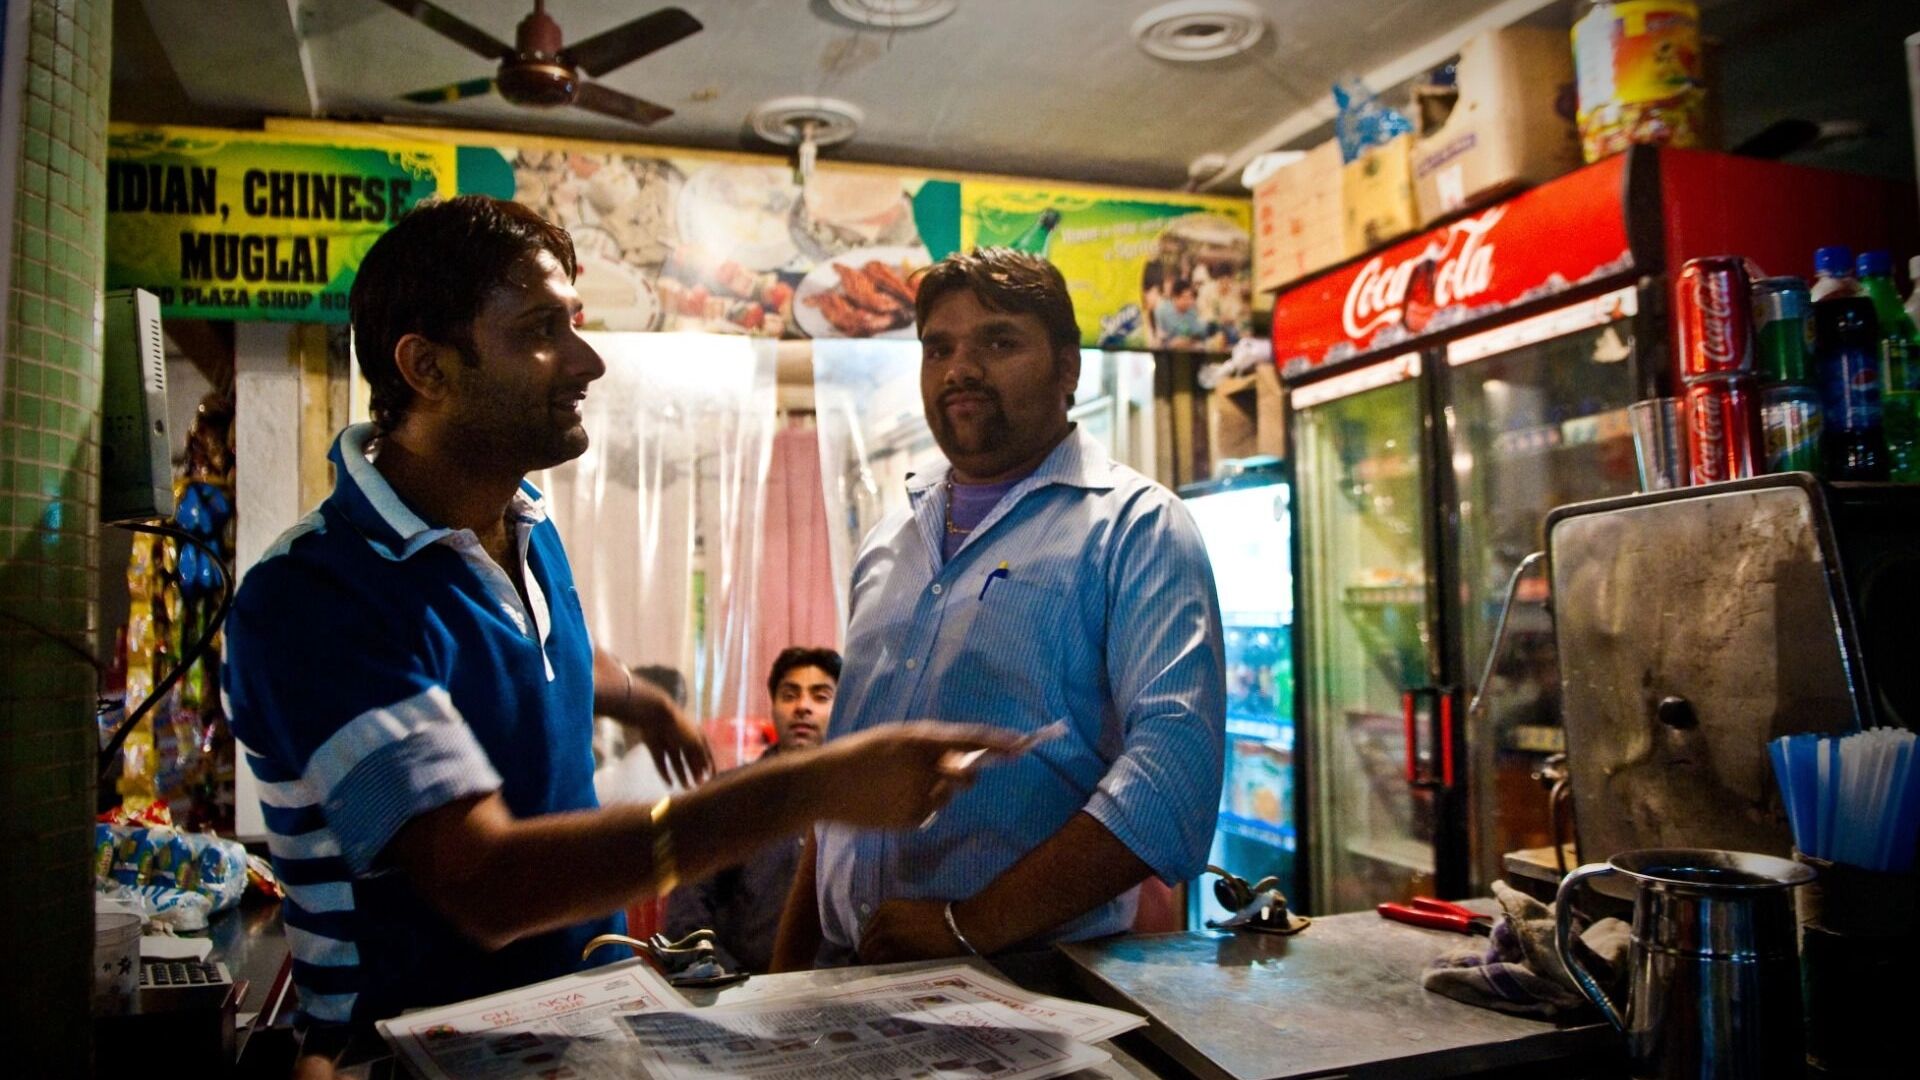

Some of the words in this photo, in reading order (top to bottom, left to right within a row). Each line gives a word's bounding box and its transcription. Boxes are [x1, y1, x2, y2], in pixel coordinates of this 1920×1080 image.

[244, 170, 411, 222] CHINESE
[180, 233, 328, 283] MUGLAI
[182, 288, 250, 308] PLAZA
[257, 290, 312, 309] SHOP
